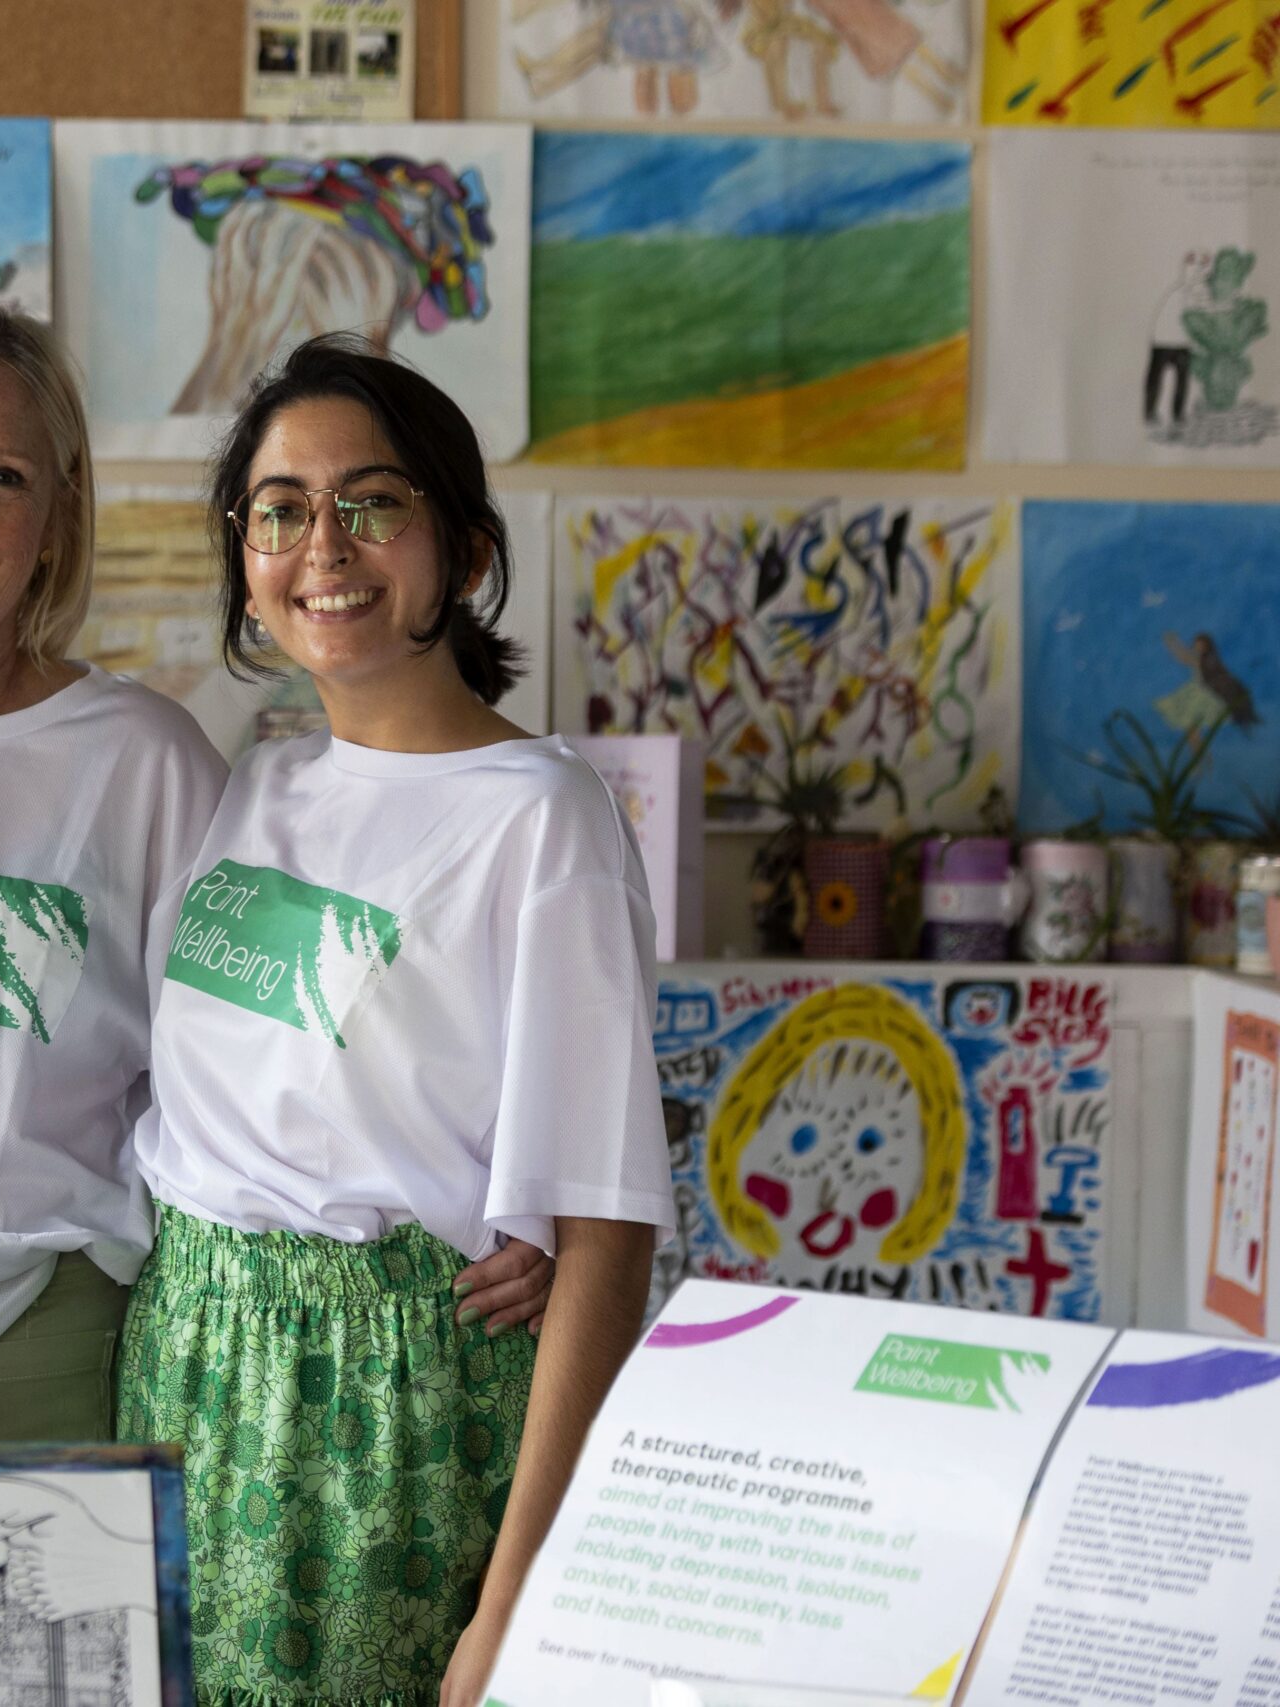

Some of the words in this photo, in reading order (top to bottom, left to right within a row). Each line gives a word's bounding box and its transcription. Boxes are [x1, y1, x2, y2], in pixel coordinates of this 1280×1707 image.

[191, 871, 260, 919] Paint
[170, 913, 287, 1001] Wellbeing
[870, 1362, 978, 1402] Wellbeing
[881, 1338, 942, 1368] Paint
[611, 1457, 739, 1492] therapeutic
[741, 1480, 875, 1515] programme
[620, 1429, 636, 1449] A
[641, 1435, 763, 1470] structured,
[769, 1454, 868, 1487] creative,
[586, 1512, 658, 1539] people
[660, 1522, 715, 1550] living
[719, 1532, 764, 1556] with
[768, 1543, 847, 1571] various
[851, 1555, 923, 1583] issues
[598, 1486, 662, 1511] aimed
[664, 1497, 688, 1514] at
[692, 1499, 793, 1535] improving
[798, 1516, 833, 1538] the
[837, 1522, 888, 1548] lives
[891, 1531, 918, 1552] of
[562, 1565, 641, 1597] anxiety,
[646, 1580, 711, 1606] social
[712, 1593, 794, 1623] anxiety,
[799, 1605, 844, 1630] loss
[574, 1536, 667, 1571] including
[669, 1554, 790, 1593] depression,
[796, 1575, 892, 1611] isolation,
[552, 1593, 593, 1615] and
[596, 1599, 660, 1627] health
[664, 1613, 766, 1647] concerns.
[537, 1639, 564, 1657] See
[567, 1647, 597, 1662] over
[600, 1651, 622, 1667] for
[622, 1657, 657, 1675] more
